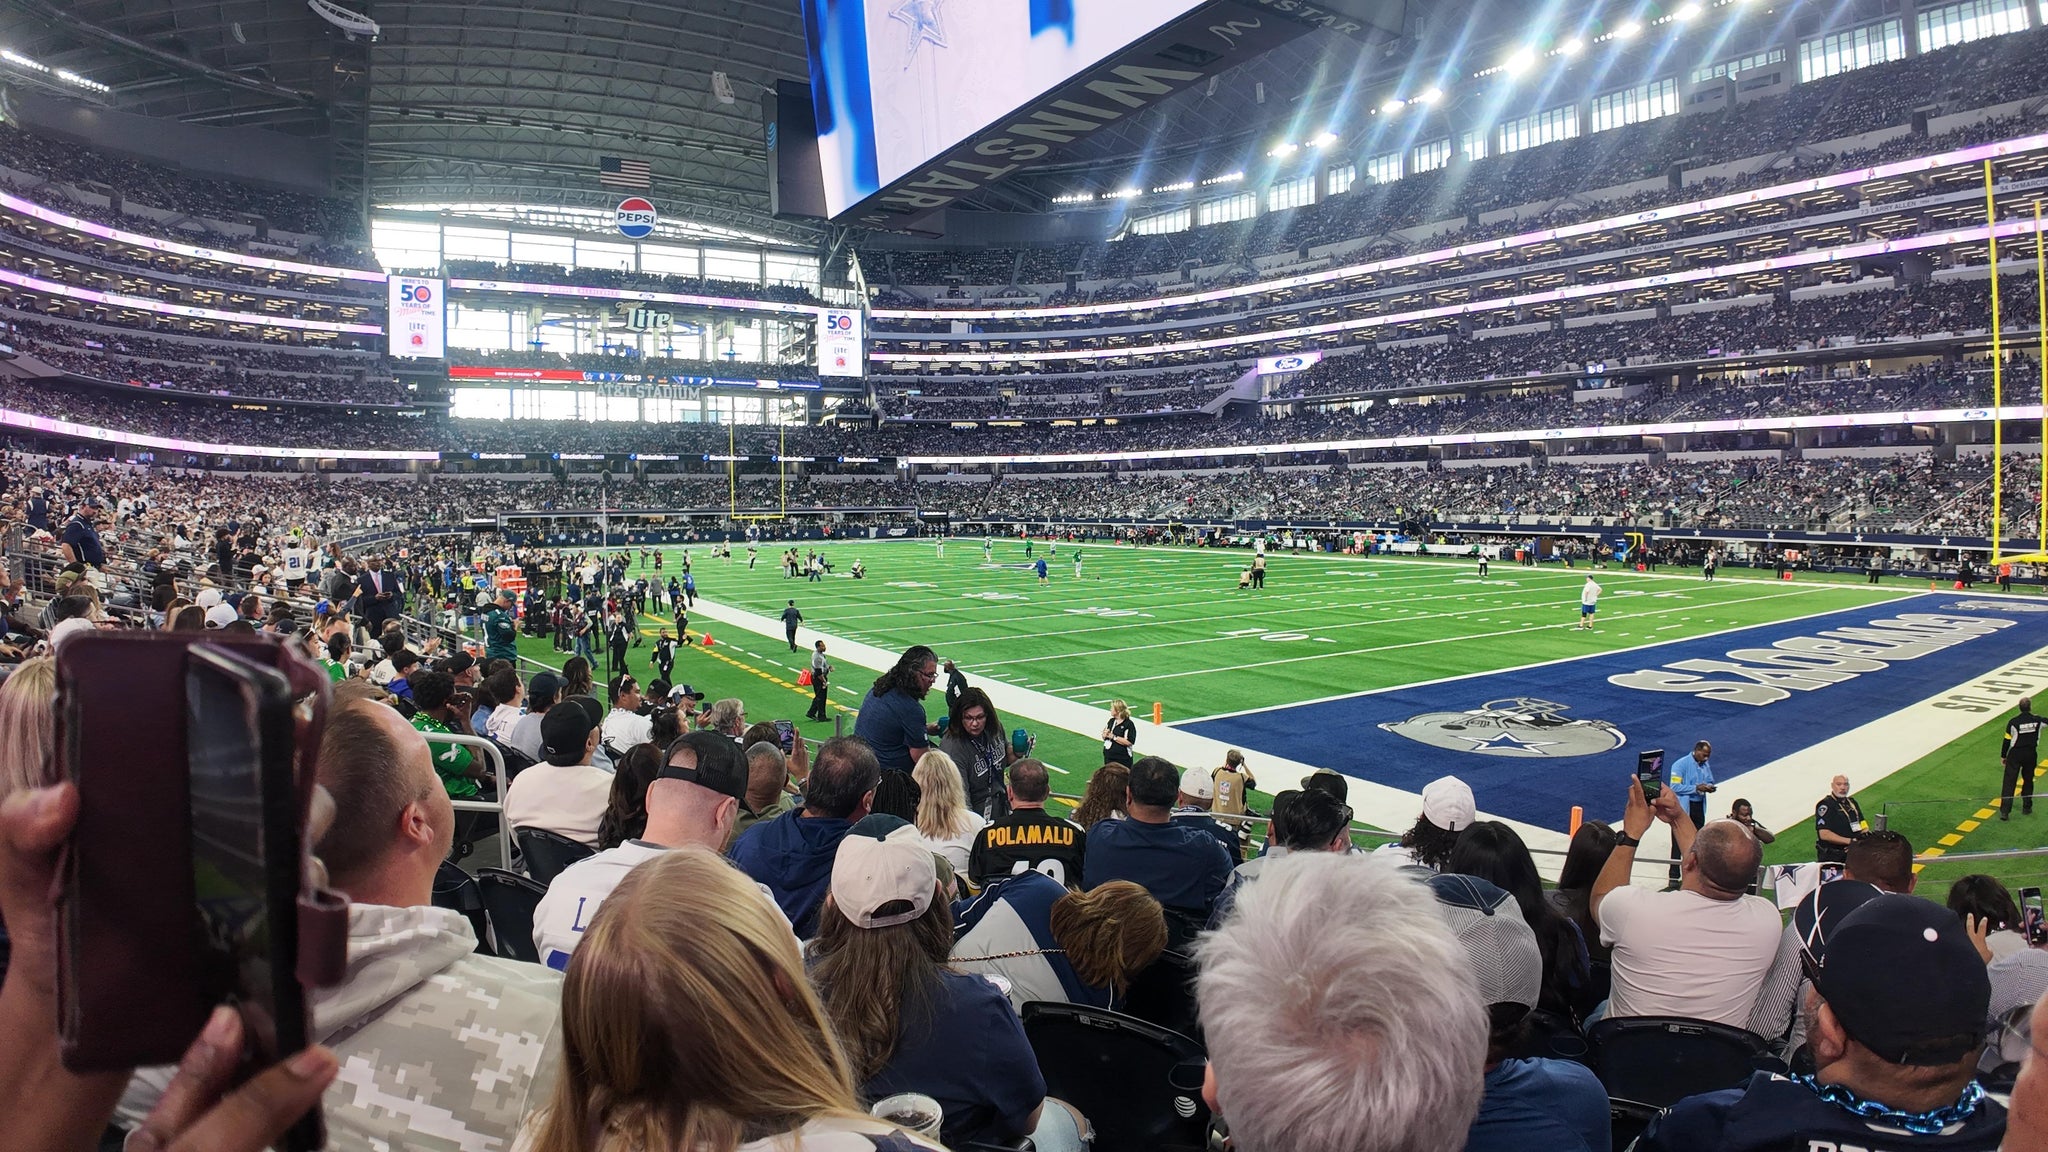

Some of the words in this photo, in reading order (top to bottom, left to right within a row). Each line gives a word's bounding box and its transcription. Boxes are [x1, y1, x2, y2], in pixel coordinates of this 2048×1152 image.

[879, 64, 1204, 209] WINSTAR
[1871, 204, 1894, 214] LARRY
[1894, 201, 1917, 210] ALLEN
[617, 212, 655, 224] PEPSI
[401, 285, 431, 303] 50
[625, 307, 672, 333] Lite
[827, 315, 852, 330] 50
[595, 383, 633, 398] AT&T
[636, 384, 700, 400] STADIUM
[289, 556, 301, 568] 21
[1608, 613, 2018, 706] COWBOYS
[1972, 680, 2034, 695] OF
[1931, 695, 2007, 713] US
[987, 825, 1074, 849] POLAMALU
[462, 844, 468, 854] 3
